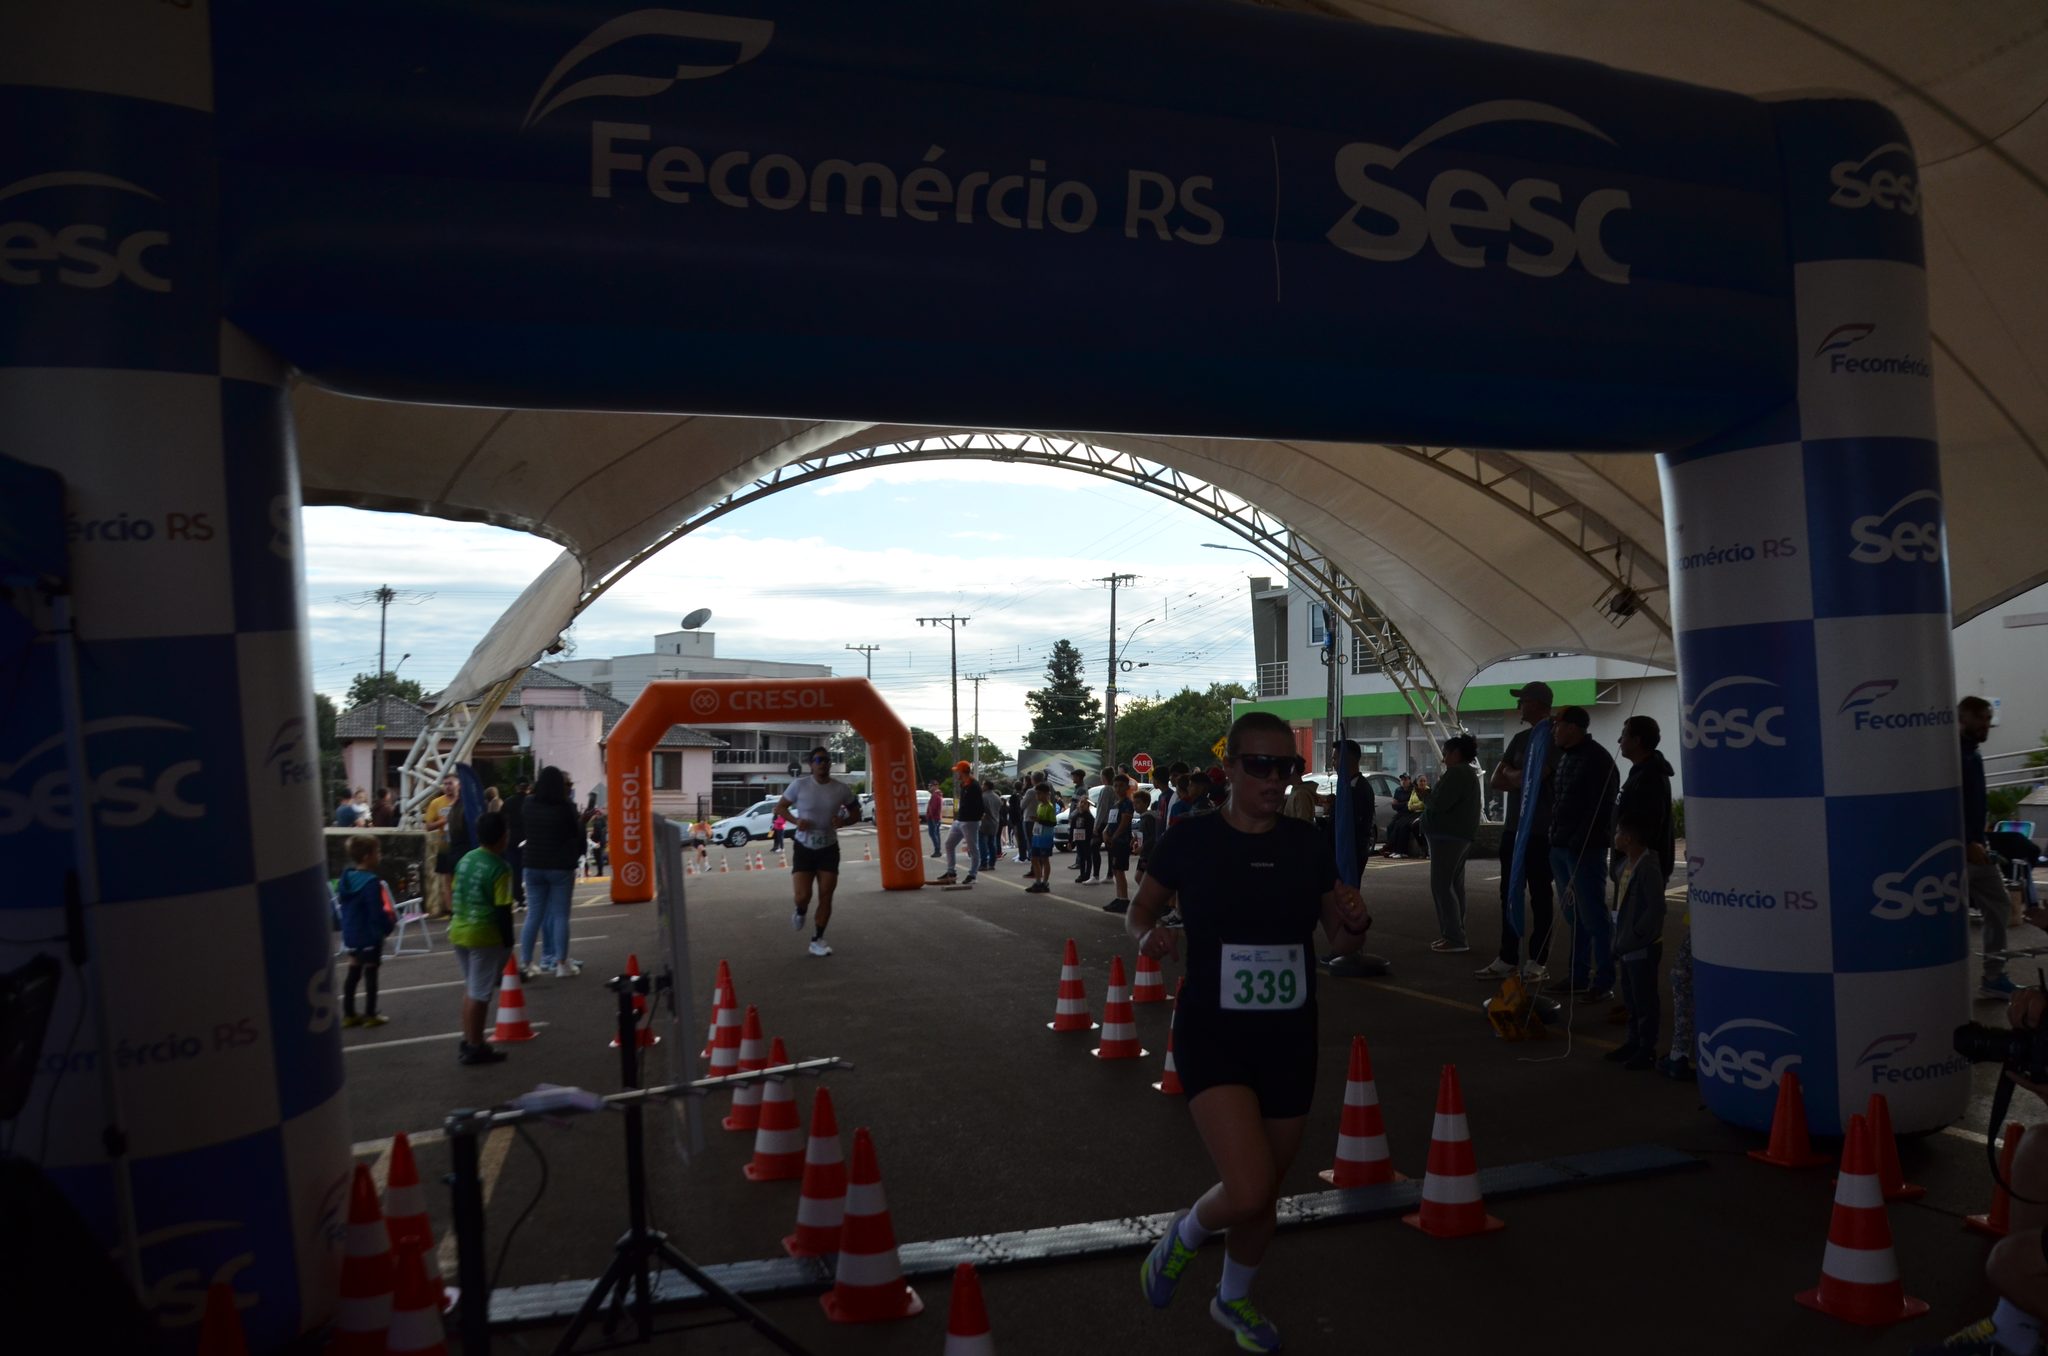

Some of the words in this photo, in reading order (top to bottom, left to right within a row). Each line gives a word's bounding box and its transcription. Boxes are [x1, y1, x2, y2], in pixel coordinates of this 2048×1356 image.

[591, 120, 1098, 235] Fecomércio
[1124, 169, 1226, 246] RS
[1828, 159, 1920, 216] Ses
[1325, 140, 1632, 286] Sesc
[166, 511, 215, 542] RS
[1762, 537, 1798, 559] RS
[728, 687, 833, 711] CRESOL
[622, 765, 642, 856] CRESOL
[890, 754, 913, 841] CRESOL
[1783, 890, 1819, 910] RS
[1233, 968, 1297, 1005] 339
[213, 1018, 258, 1051] RS
